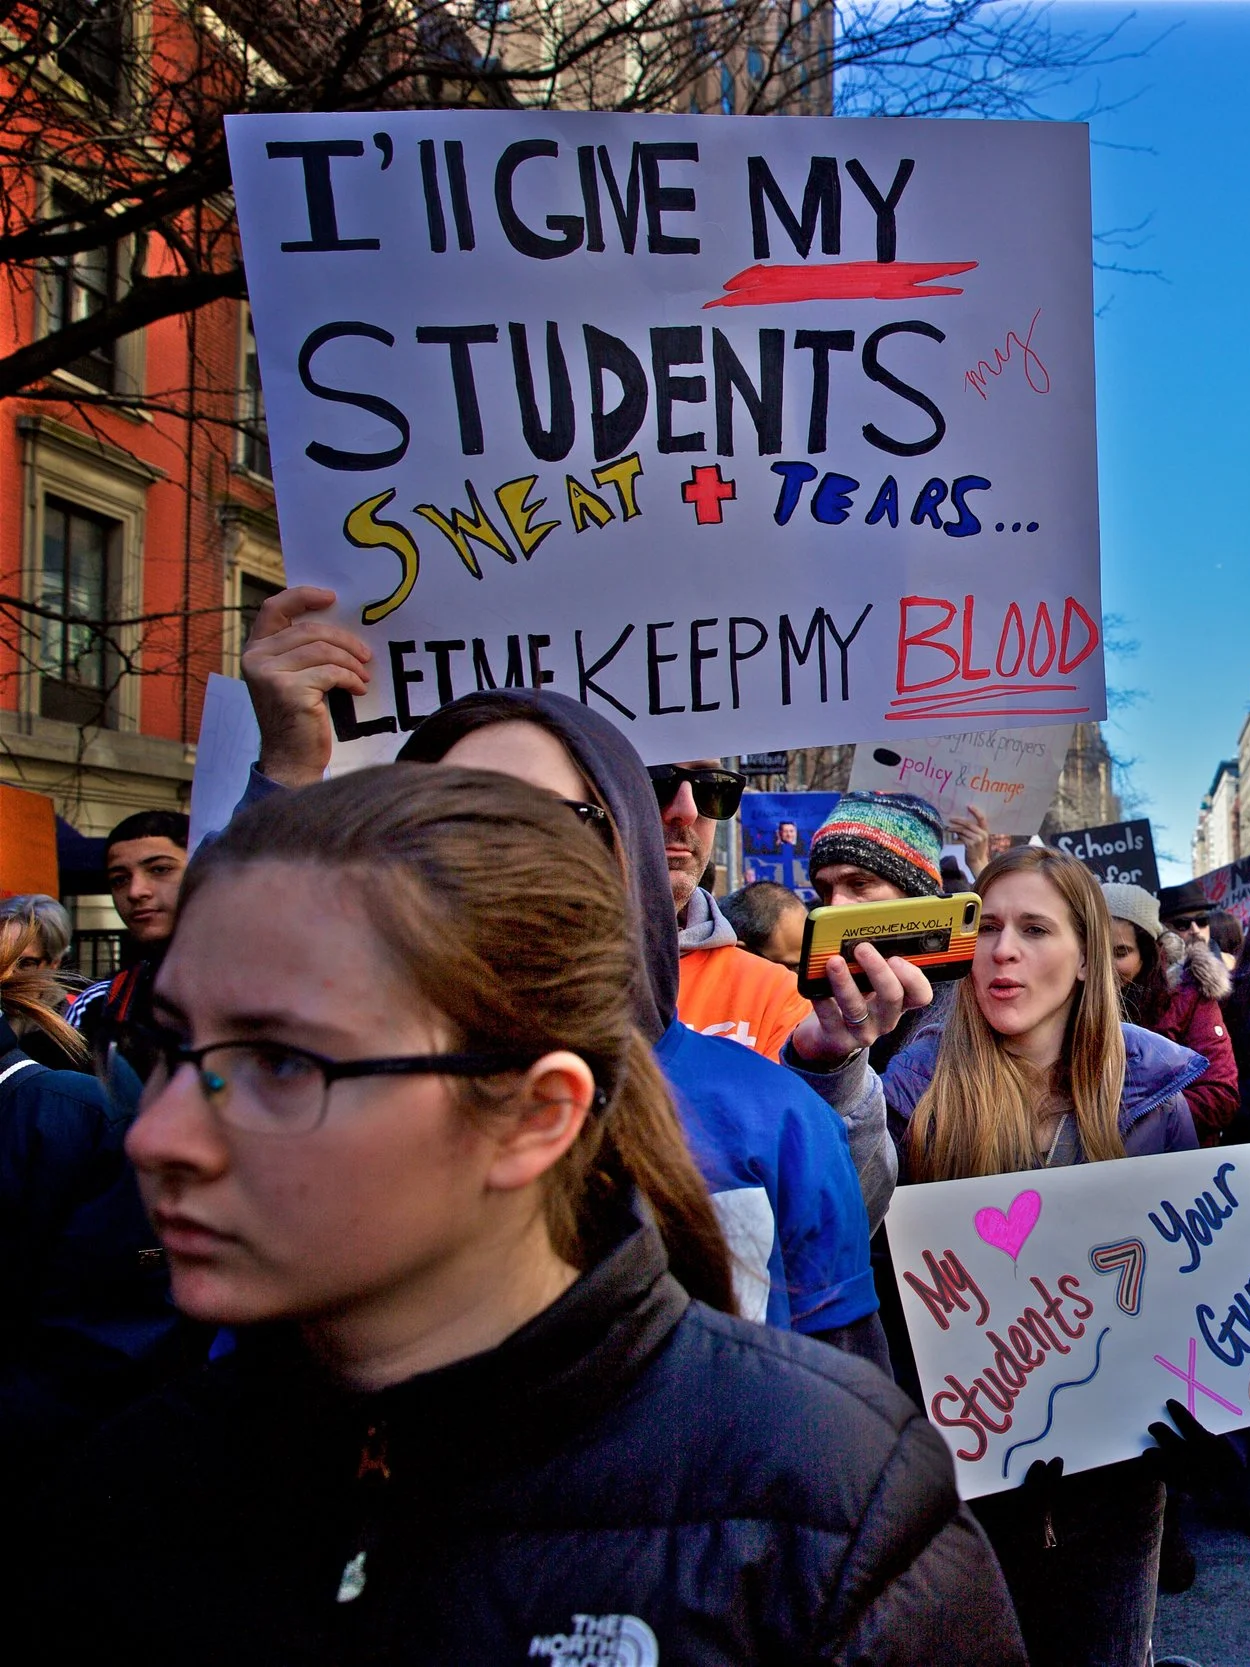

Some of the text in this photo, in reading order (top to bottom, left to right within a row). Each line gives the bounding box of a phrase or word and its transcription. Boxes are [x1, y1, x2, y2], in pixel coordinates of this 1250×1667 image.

[493, 138, 701, 261] GIVE
[746, 154, 915, 264] MY
[297, 320, 947, 473] STUDENTS
[342, 451, 644, 626] SWEAT
[770, 460, 1041, 539] TEARS...
[326, 638, 467, 743] LET
[574, 612, 769, 724] KEEP
[776, 602, 875, 712] MY
[893, 594, 1101, 696] BLOOD
[900, 756, 953, 794] policy
[969, 767, 1026, 803] change
[1057, 826, 1145, 860] Schools
[1105, 864, 1144, 885] for
[842, 922, 900, 938] AWESOME
[900, 920, 921, 932] MIX
[921, 918, 943, 930] VOL
[1147, 1161, 1240, 1274] Your
[902, 1248, 991, 1331] My
[931, 1274, 1096, 1463] Students
[528, 1633, 617, 1658] NORTH
[571, 1613, 622, 1634] THE
